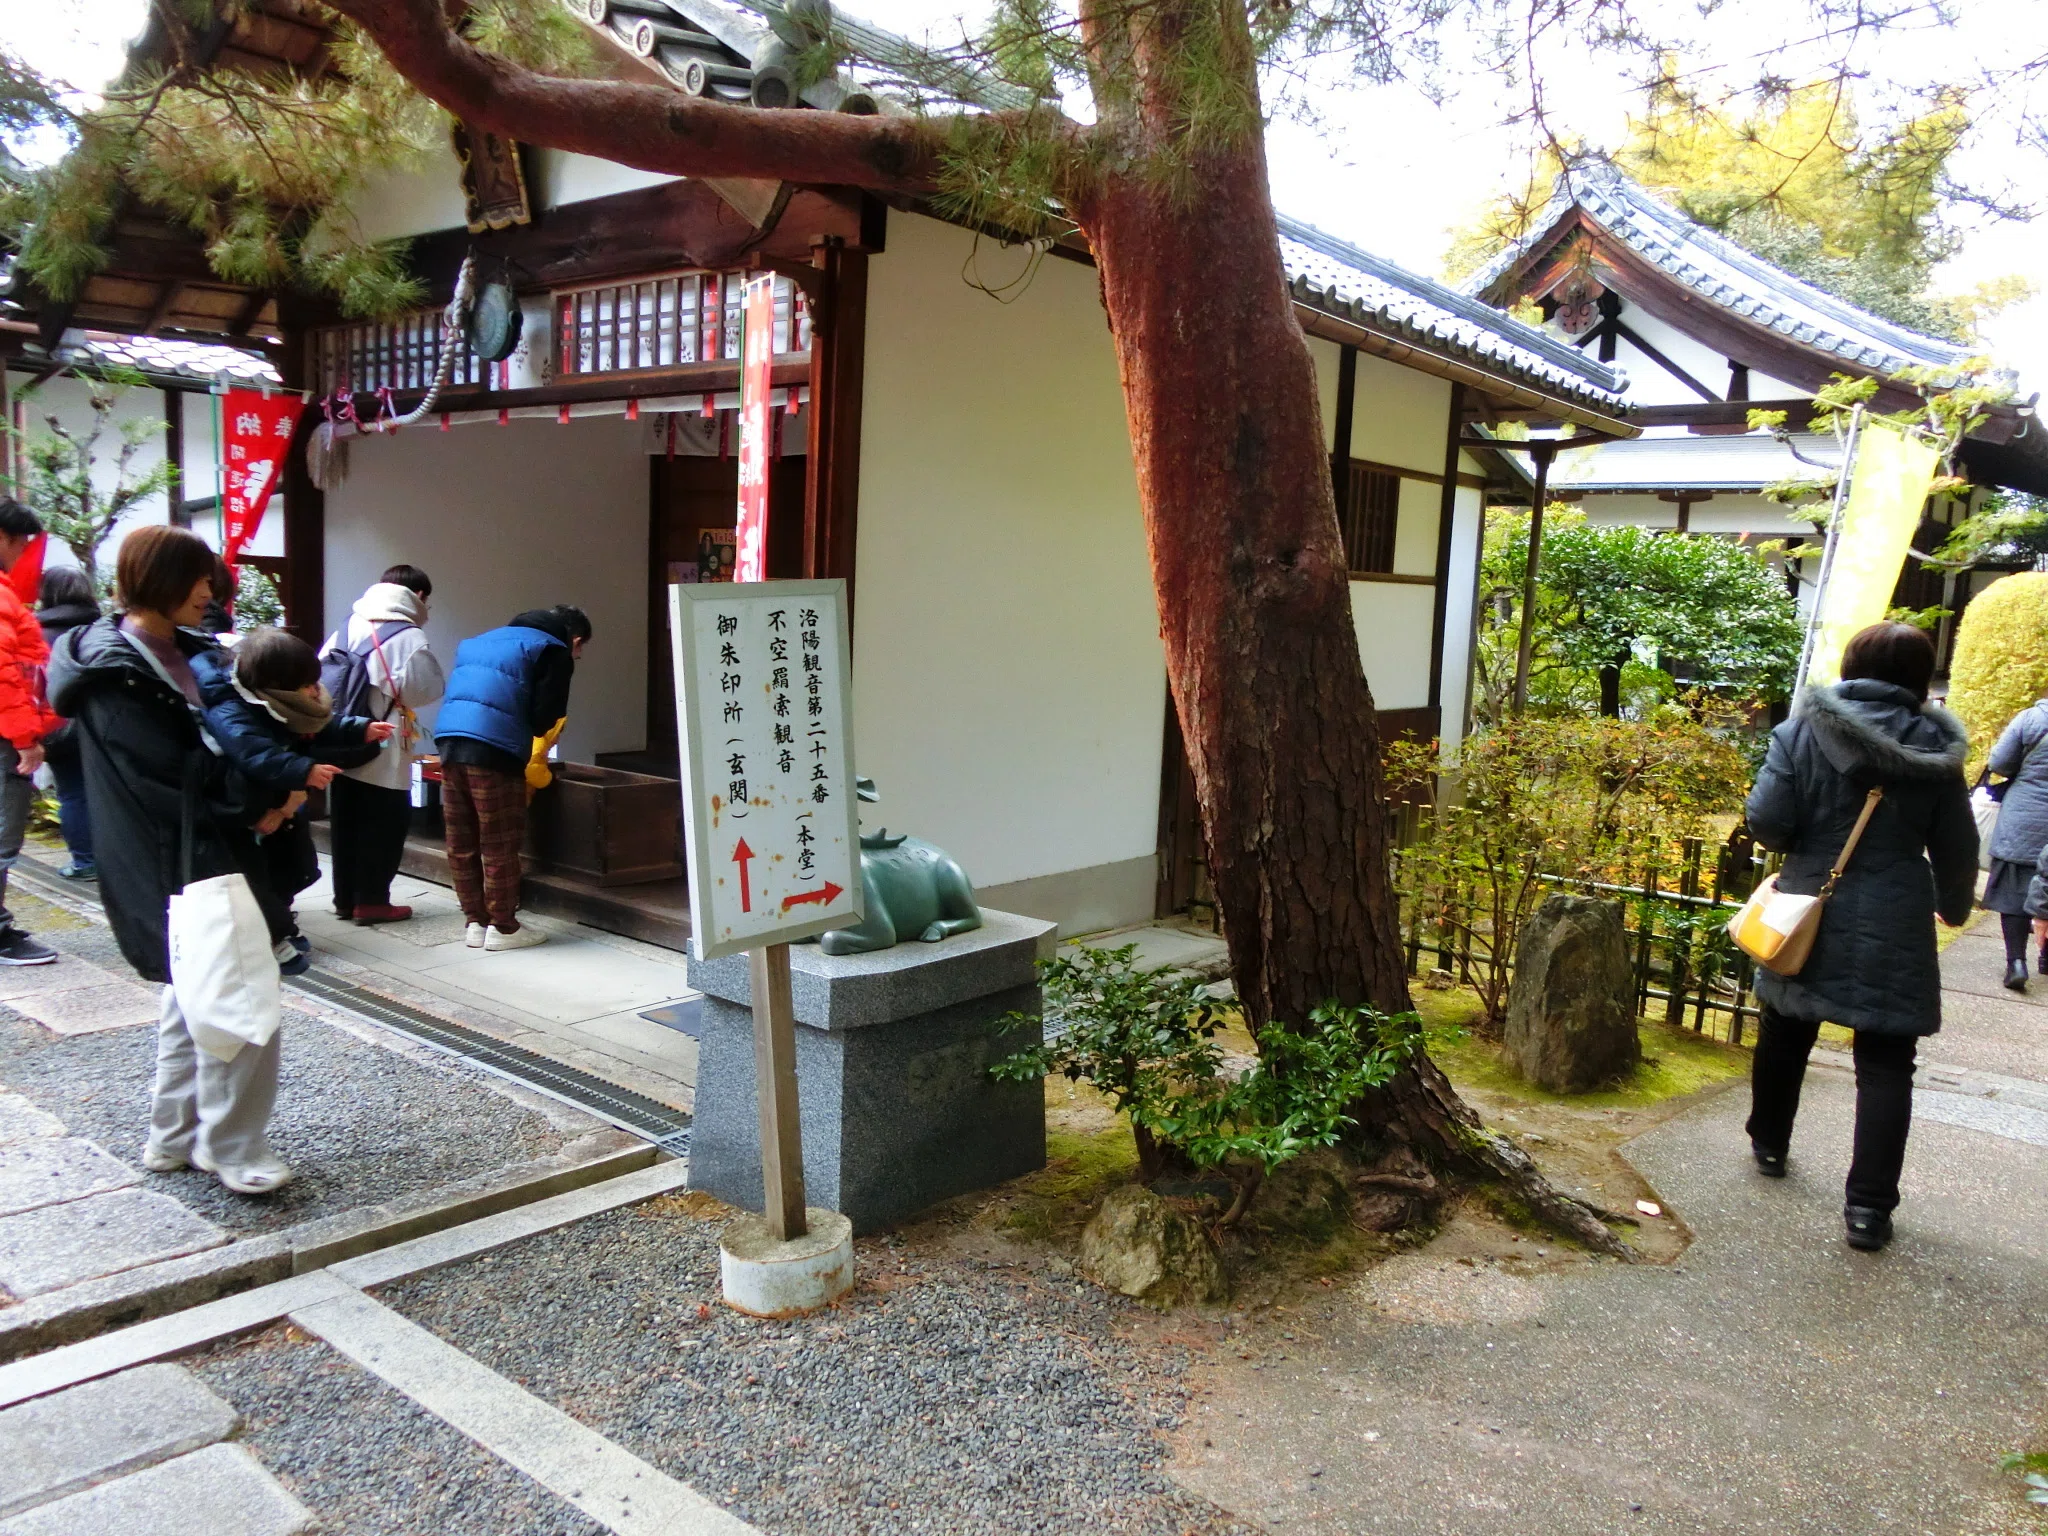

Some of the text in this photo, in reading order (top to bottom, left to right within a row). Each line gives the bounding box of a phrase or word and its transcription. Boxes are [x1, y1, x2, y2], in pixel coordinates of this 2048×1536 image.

[800, 609, 829, 803] 洛陽観音第二十五番
